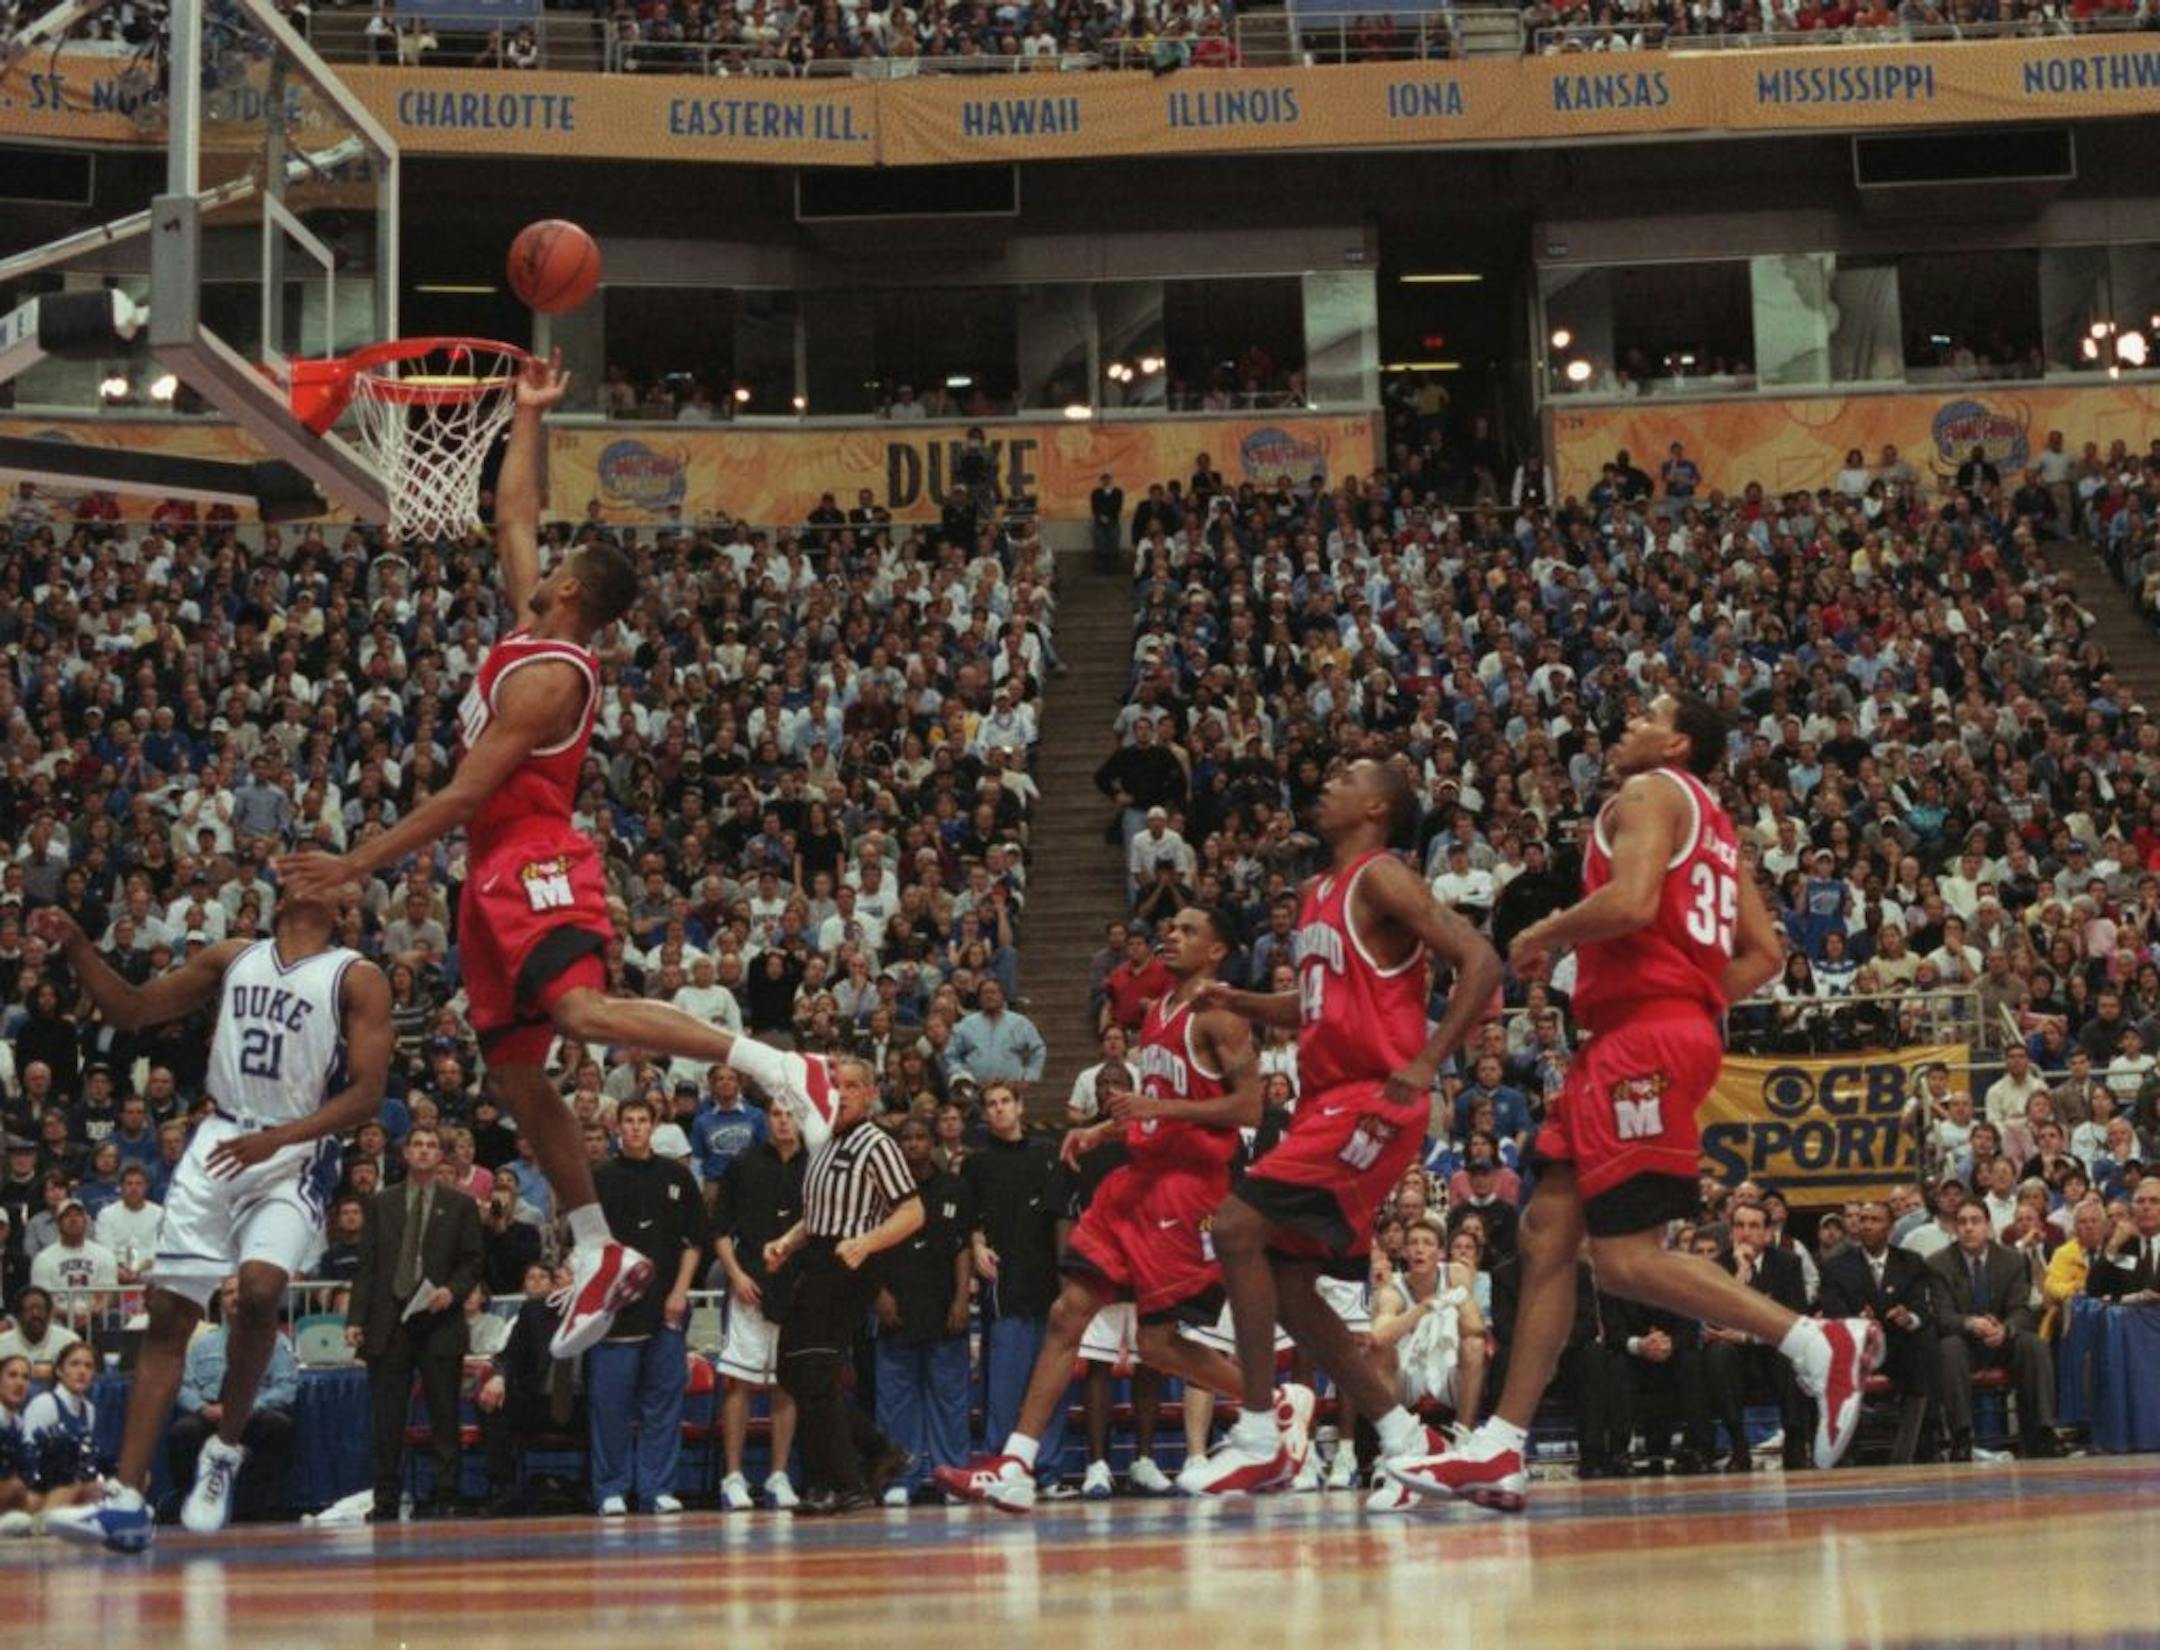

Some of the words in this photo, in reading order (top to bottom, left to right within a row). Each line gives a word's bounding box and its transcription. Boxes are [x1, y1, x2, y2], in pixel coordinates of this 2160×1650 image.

[1553, 71, 1670, 111] KANSAS
[1757, 64, 1934, 104] MISSISSIPPI
[2023, 51, 2160, 94] NORTHW
[399, 90, 575, 131] CHARLOTTE
[669, 100, 803, 138] EASTERN
[813, 104, 869, 140] ILL.
[962, 97, 1080, 136] HAWAII
[1168, 87, 1299, 128] ILLINOIS
[1388, 82, 1464, 119] IONA
[1686, 861, 1738, 957] 35
[233, 985, 314, 1033] DUKE
[240, 1027, 284, 1081] 21
